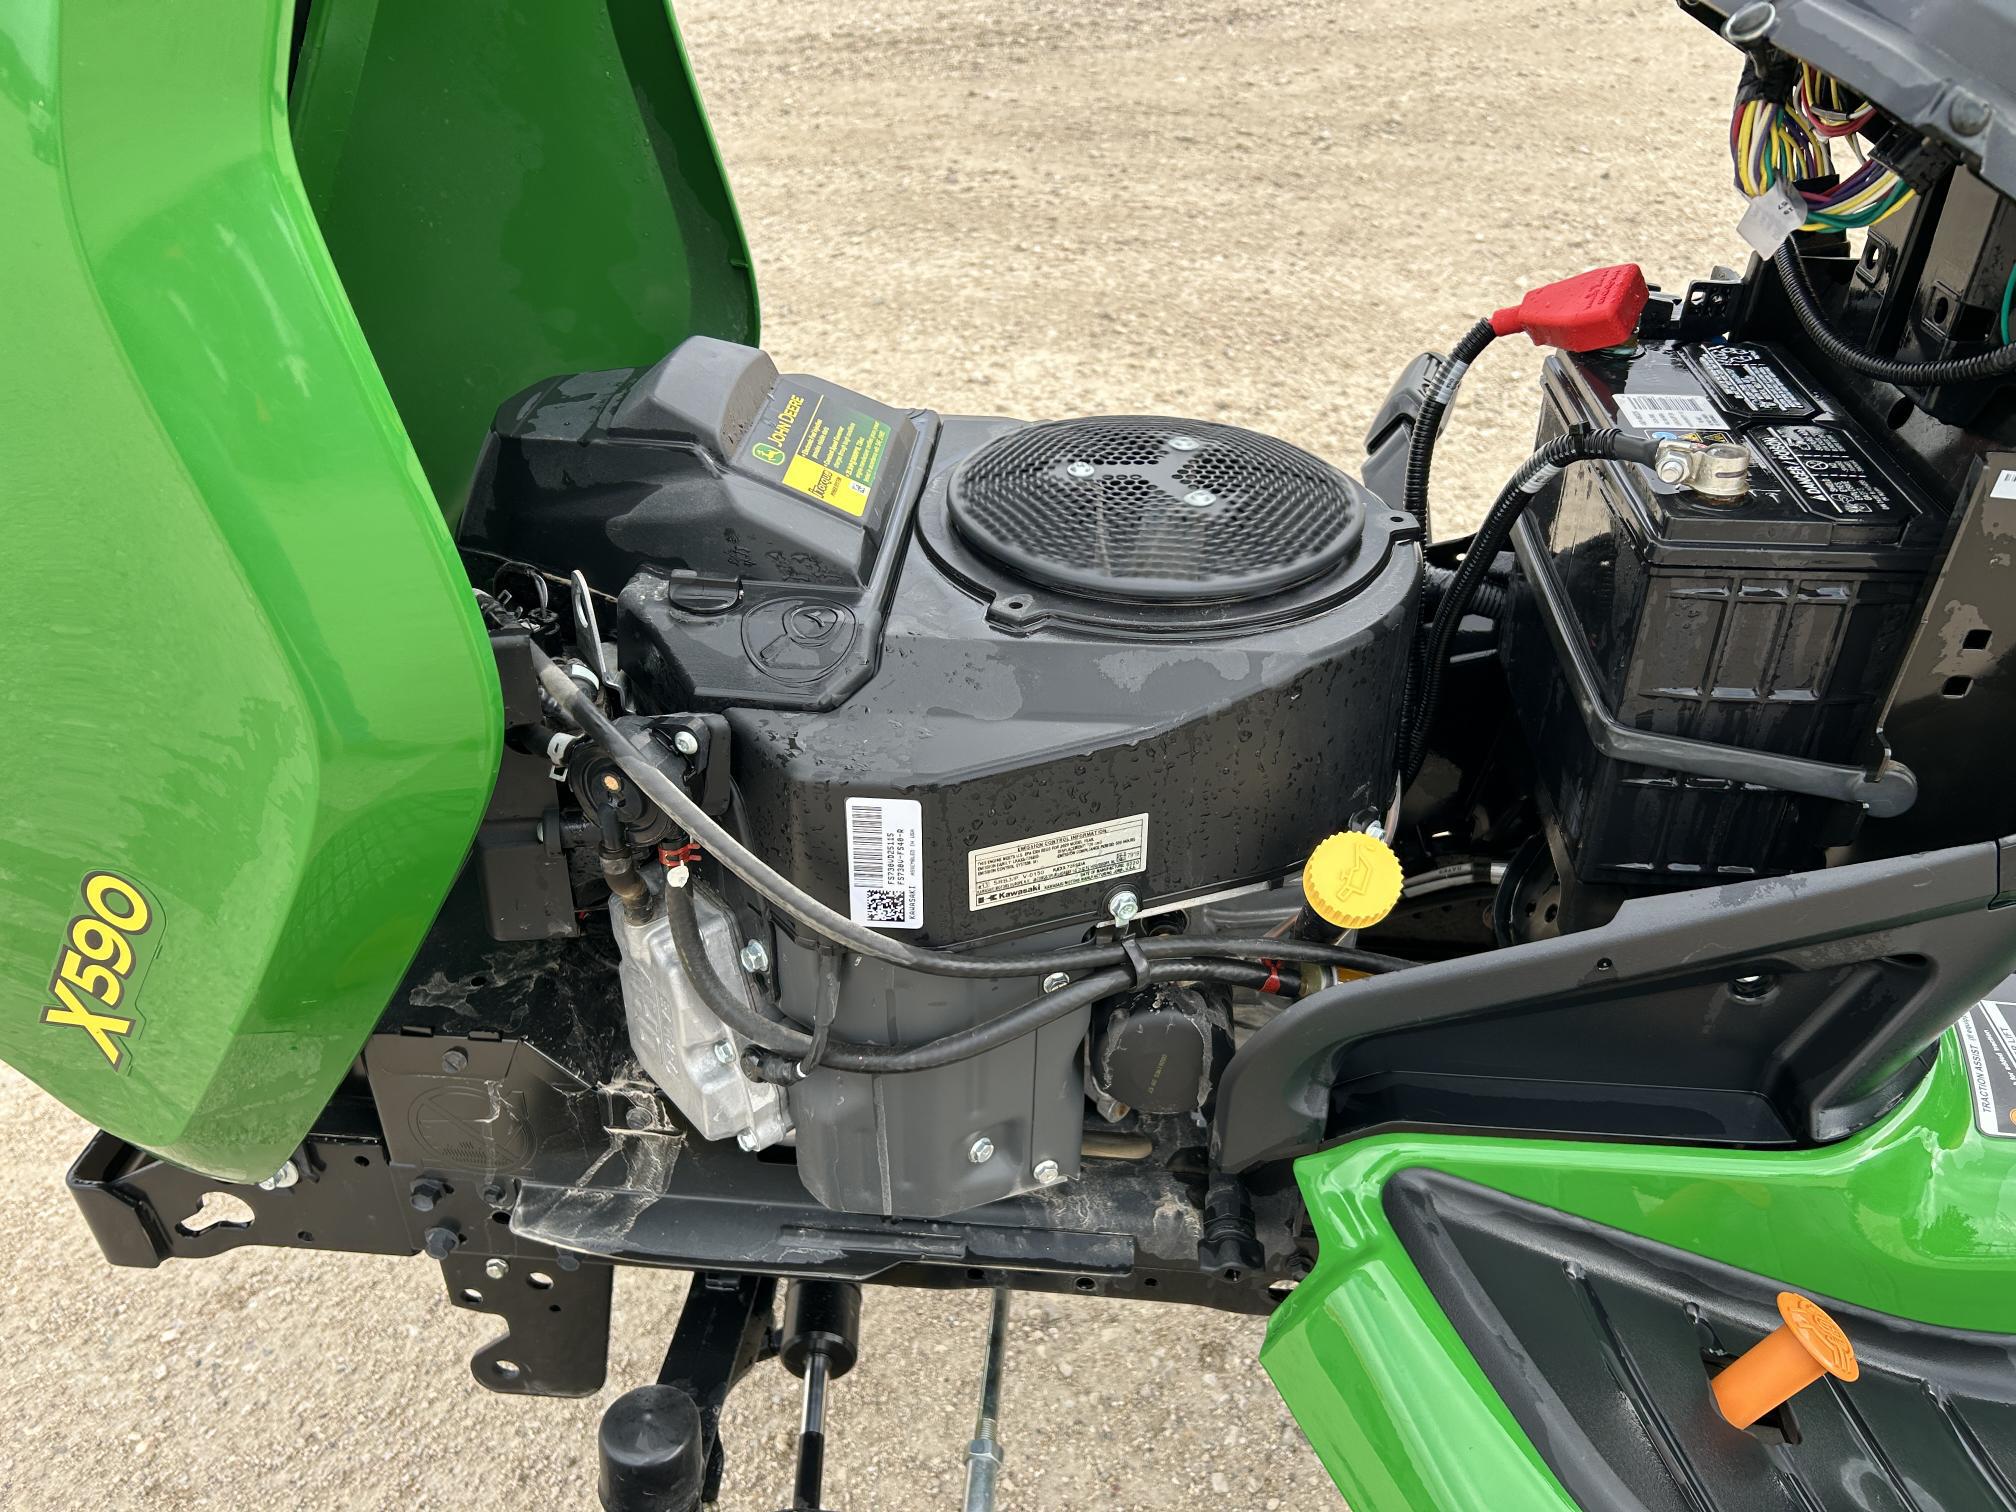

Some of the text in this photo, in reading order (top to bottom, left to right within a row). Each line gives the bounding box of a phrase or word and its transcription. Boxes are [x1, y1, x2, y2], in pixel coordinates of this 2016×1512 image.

[768, 395, 804, 447] JOHN DEERE
[1762, 437, 1793, 460] POISON
[809, 468, 833, 499] iTorque
[1786, 466, 1821, 494] DANGER
[999, 883, 1040, 899] Kawasaki
[40, 871, 152, 1071] X590
[1984, 1029, 1999, 1051] traction
[1970, 1045, 1983, 1072] ASSIST
[1977, 1073, 1991, 1113] TRACTION
